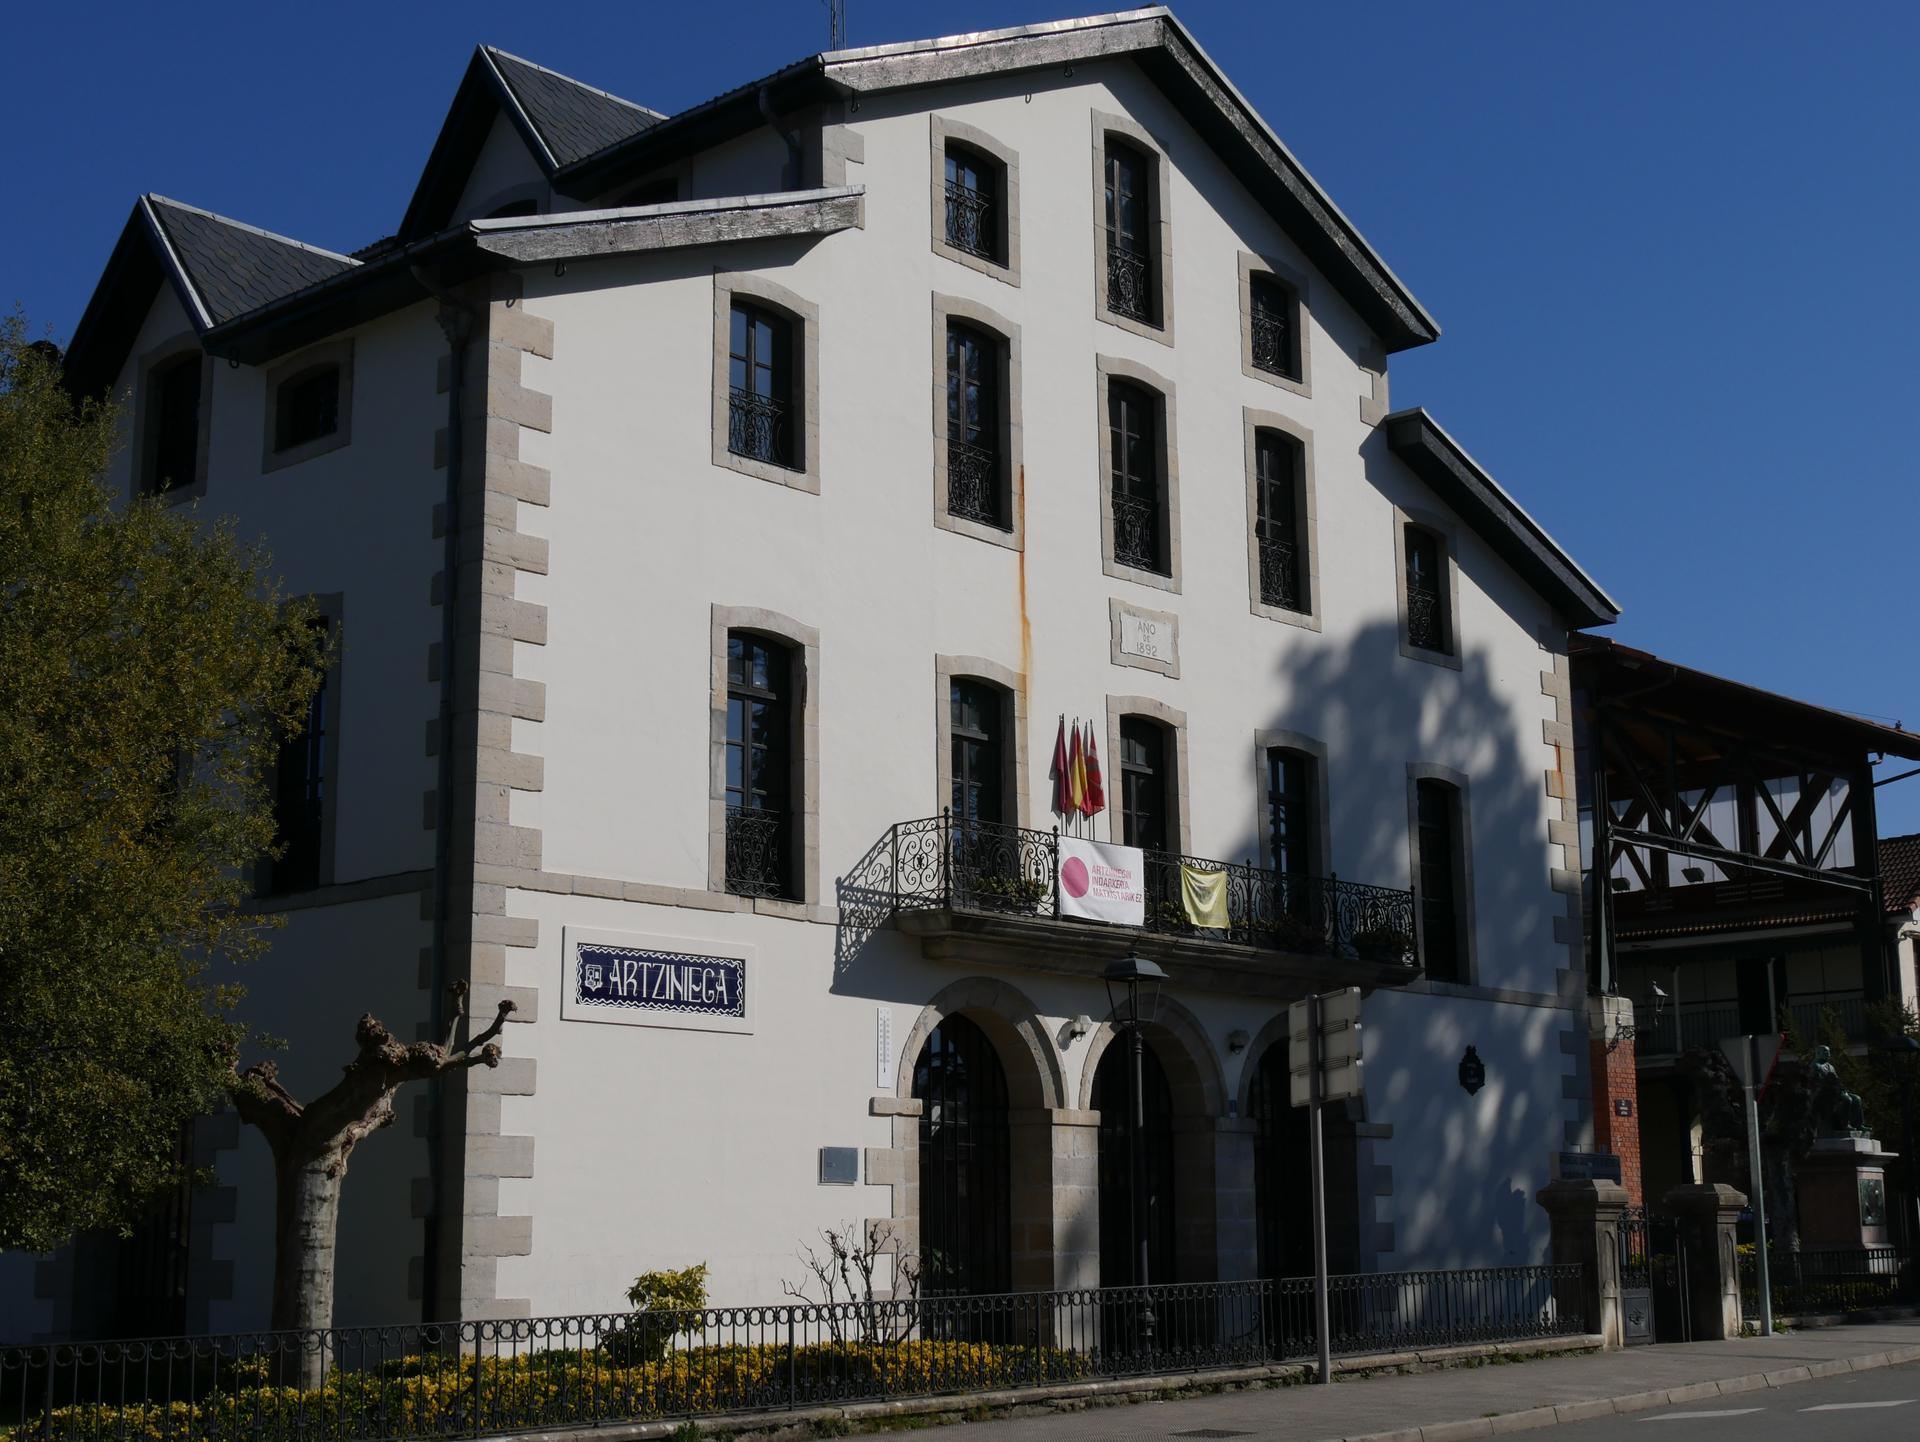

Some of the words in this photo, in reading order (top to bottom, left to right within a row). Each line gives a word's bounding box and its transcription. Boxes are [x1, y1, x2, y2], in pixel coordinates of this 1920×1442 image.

[1136, 642, 1157, 656] 1892
[1135, 893, 1143, 903] EZ
[609, 959, 729, 1005] ARTZINIEGA
